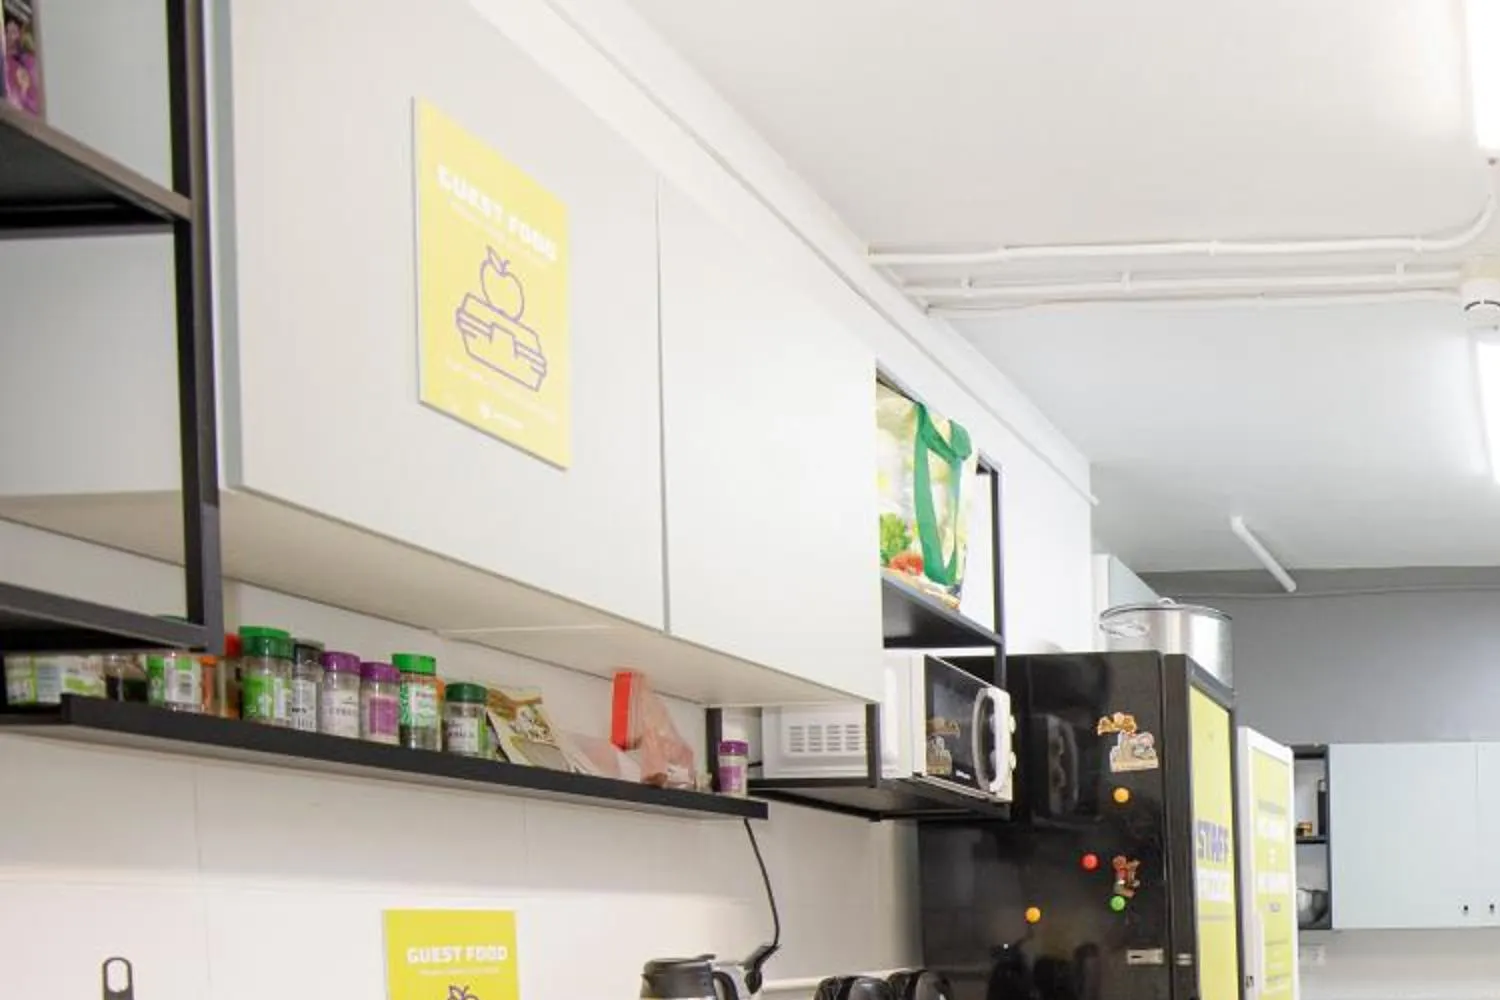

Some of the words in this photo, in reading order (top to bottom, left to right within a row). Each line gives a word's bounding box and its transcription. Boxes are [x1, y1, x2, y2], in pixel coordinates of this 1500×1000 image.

[437, 162, 503, 222] GUEST
[508, 214, 557, 261] FOOD
[407, 945, 461, 963] GUEST
[465, 944, 508, 961] FOOD
